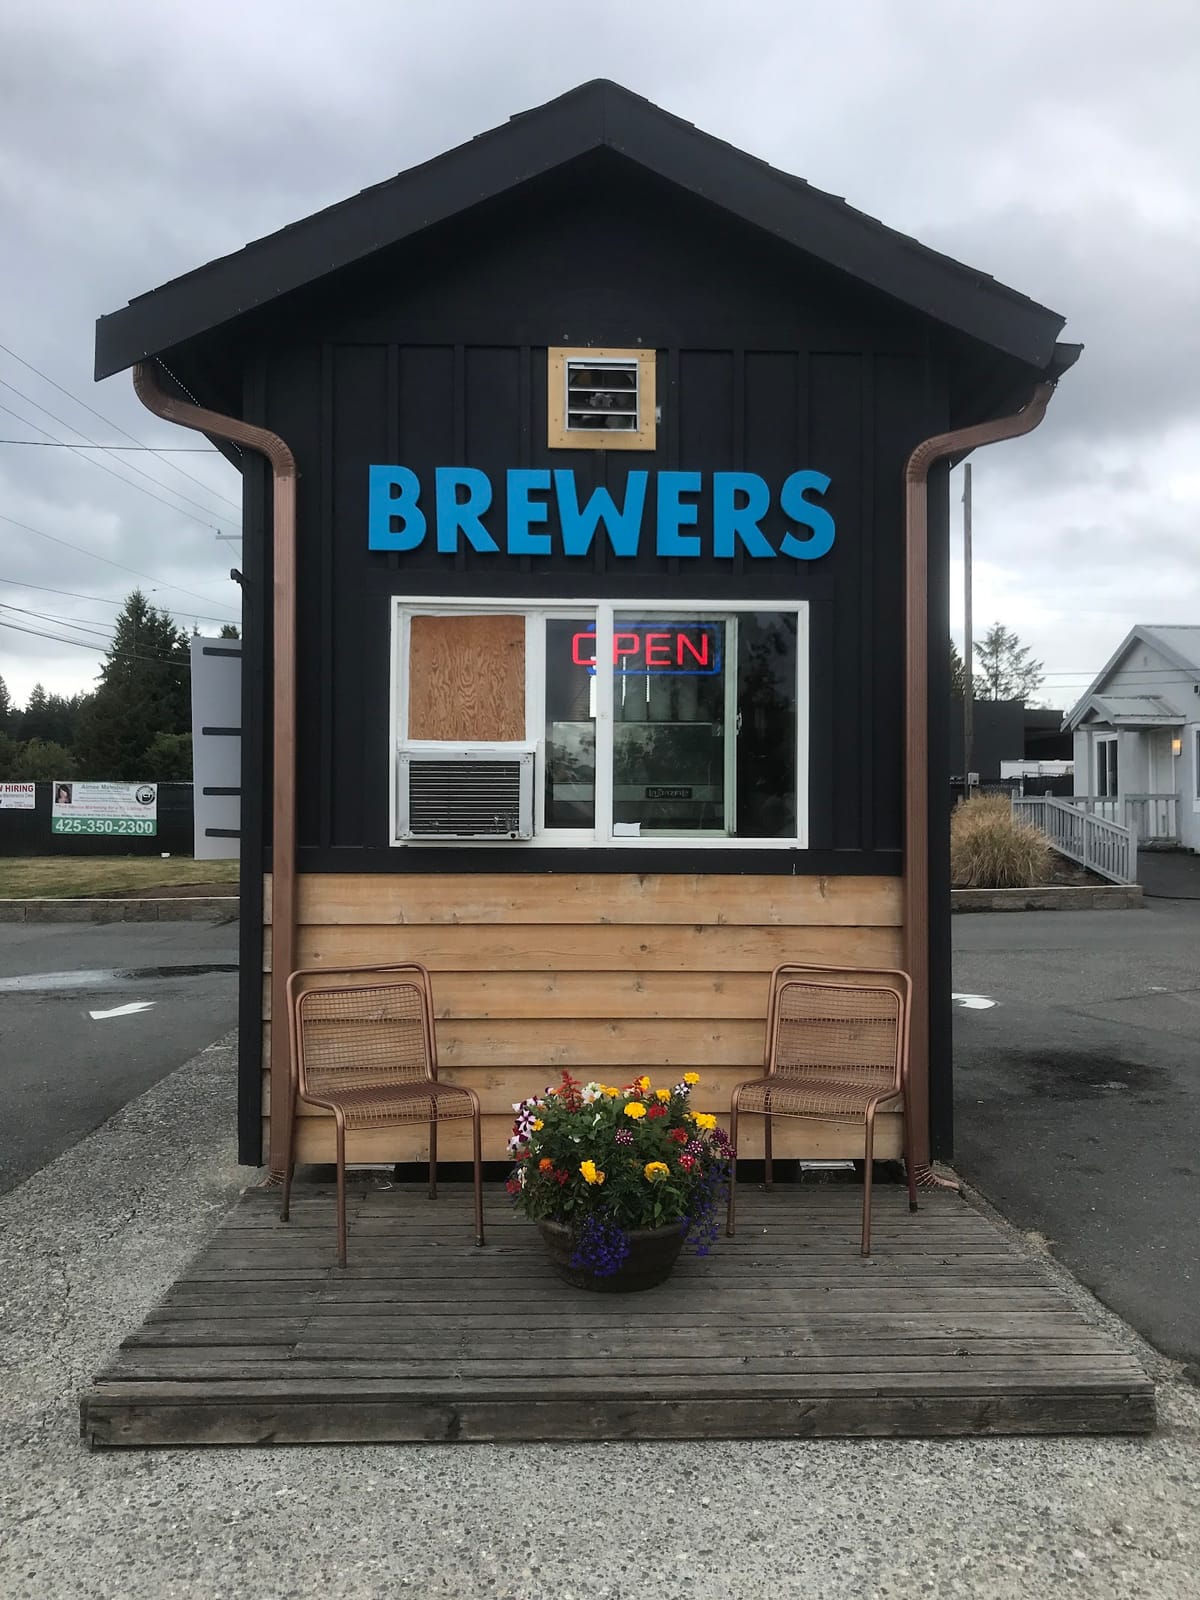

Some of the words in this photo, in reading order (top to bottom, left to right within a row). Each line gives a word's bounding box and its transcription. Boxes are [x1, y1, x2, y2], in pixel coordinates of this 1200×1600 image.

[368, 464, 836, 561] BREWERS
[572, 633, 708, 665] OPEN
[5, 784, 33, 792] HIRING
[55, 819, 153, 833] 425-350-2300
